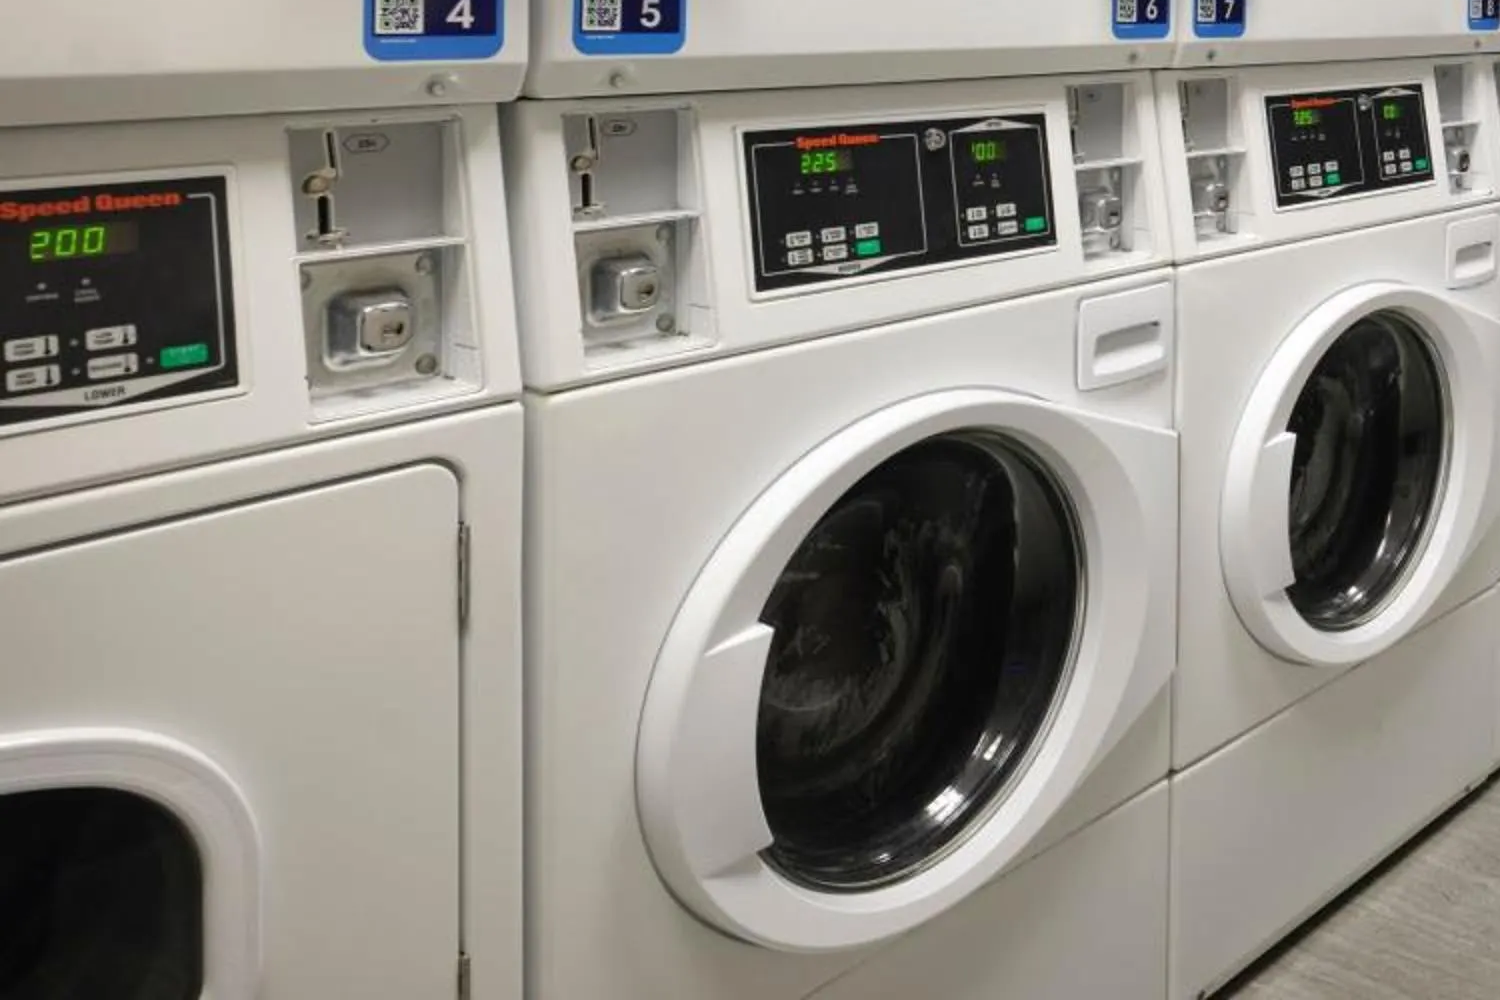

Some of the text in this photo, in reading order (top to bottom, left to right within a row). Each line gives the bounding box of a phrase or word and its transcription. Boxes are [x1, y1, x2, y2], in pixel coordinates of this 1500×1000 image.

[802, 152, 836, 175] 225
[0, 193, 182, 221] Speed Queen
[31, 226, 105, 260] 200
[84, 385, 126, 402] LOWER
